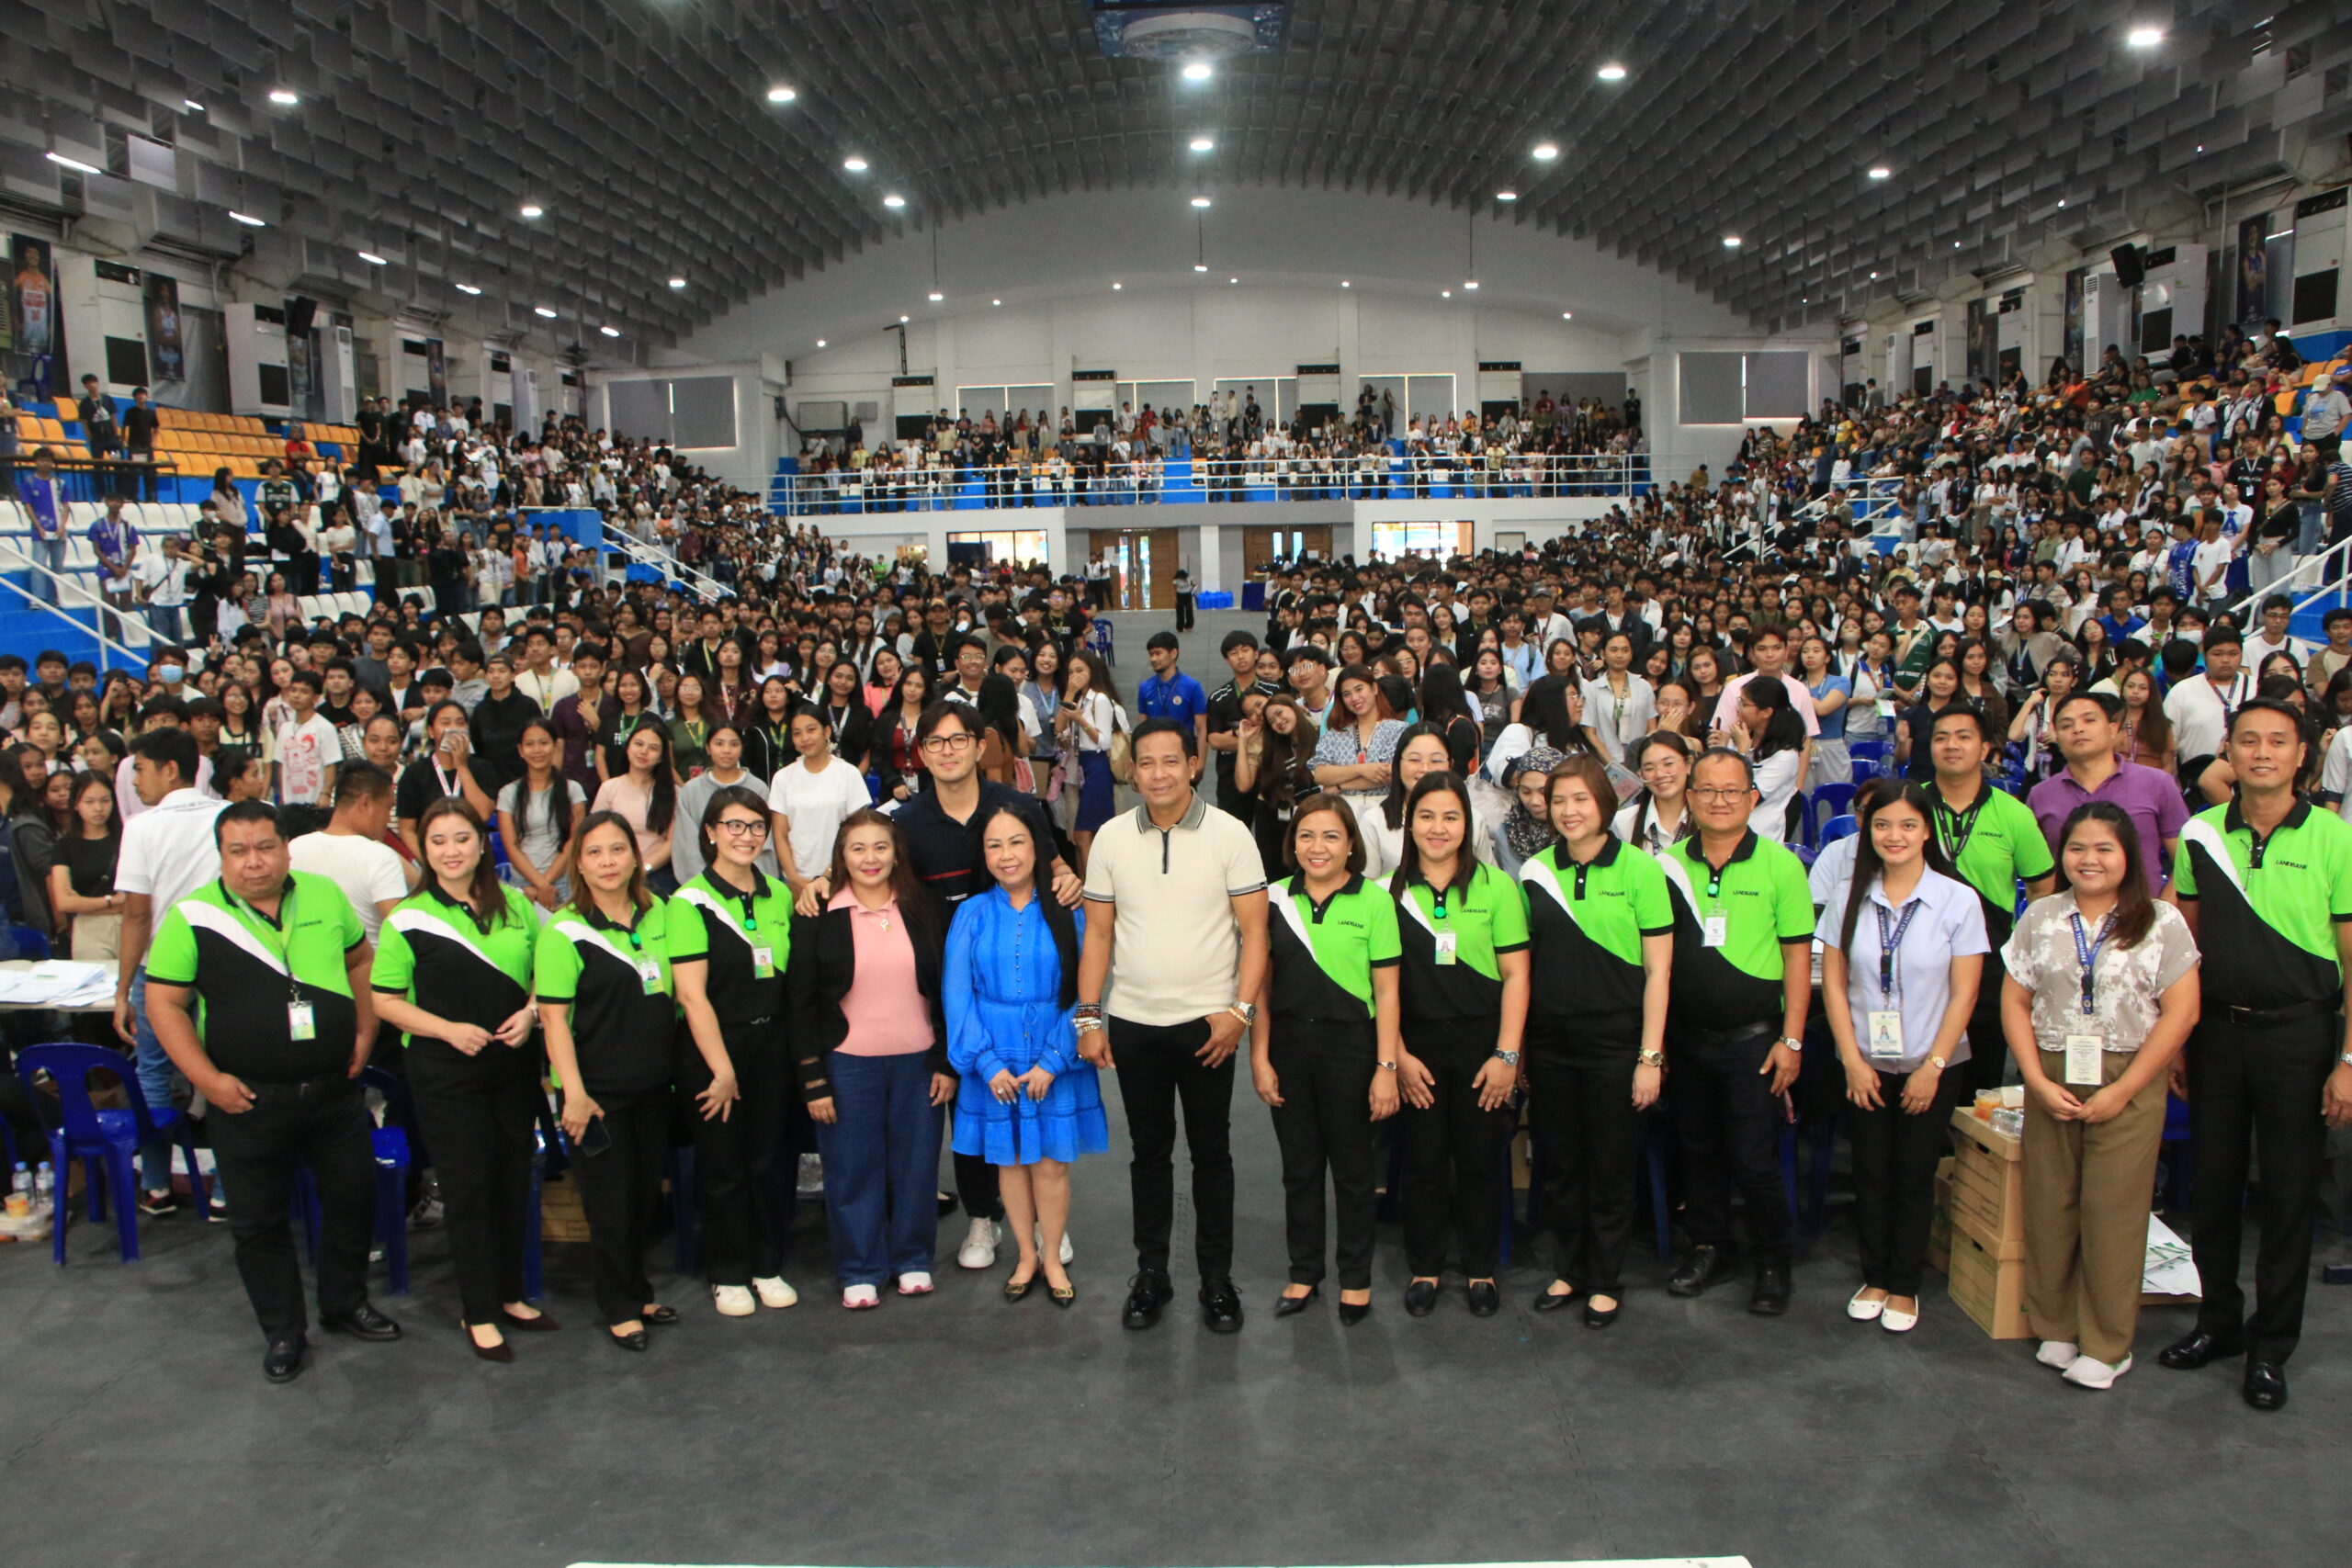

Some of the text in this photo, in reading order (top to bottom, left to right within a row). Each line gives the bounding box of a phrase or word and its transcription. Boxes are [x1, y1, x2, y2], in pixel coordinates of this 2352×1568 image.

[2276, 860, 2307, 869] LANDBANK
[1338, 920, 1364, 929] LANDBANK
[1880, 914, 1888, 946] PROVINCIAL
[2076, 931, 2087, 962] PROVINCIAL
